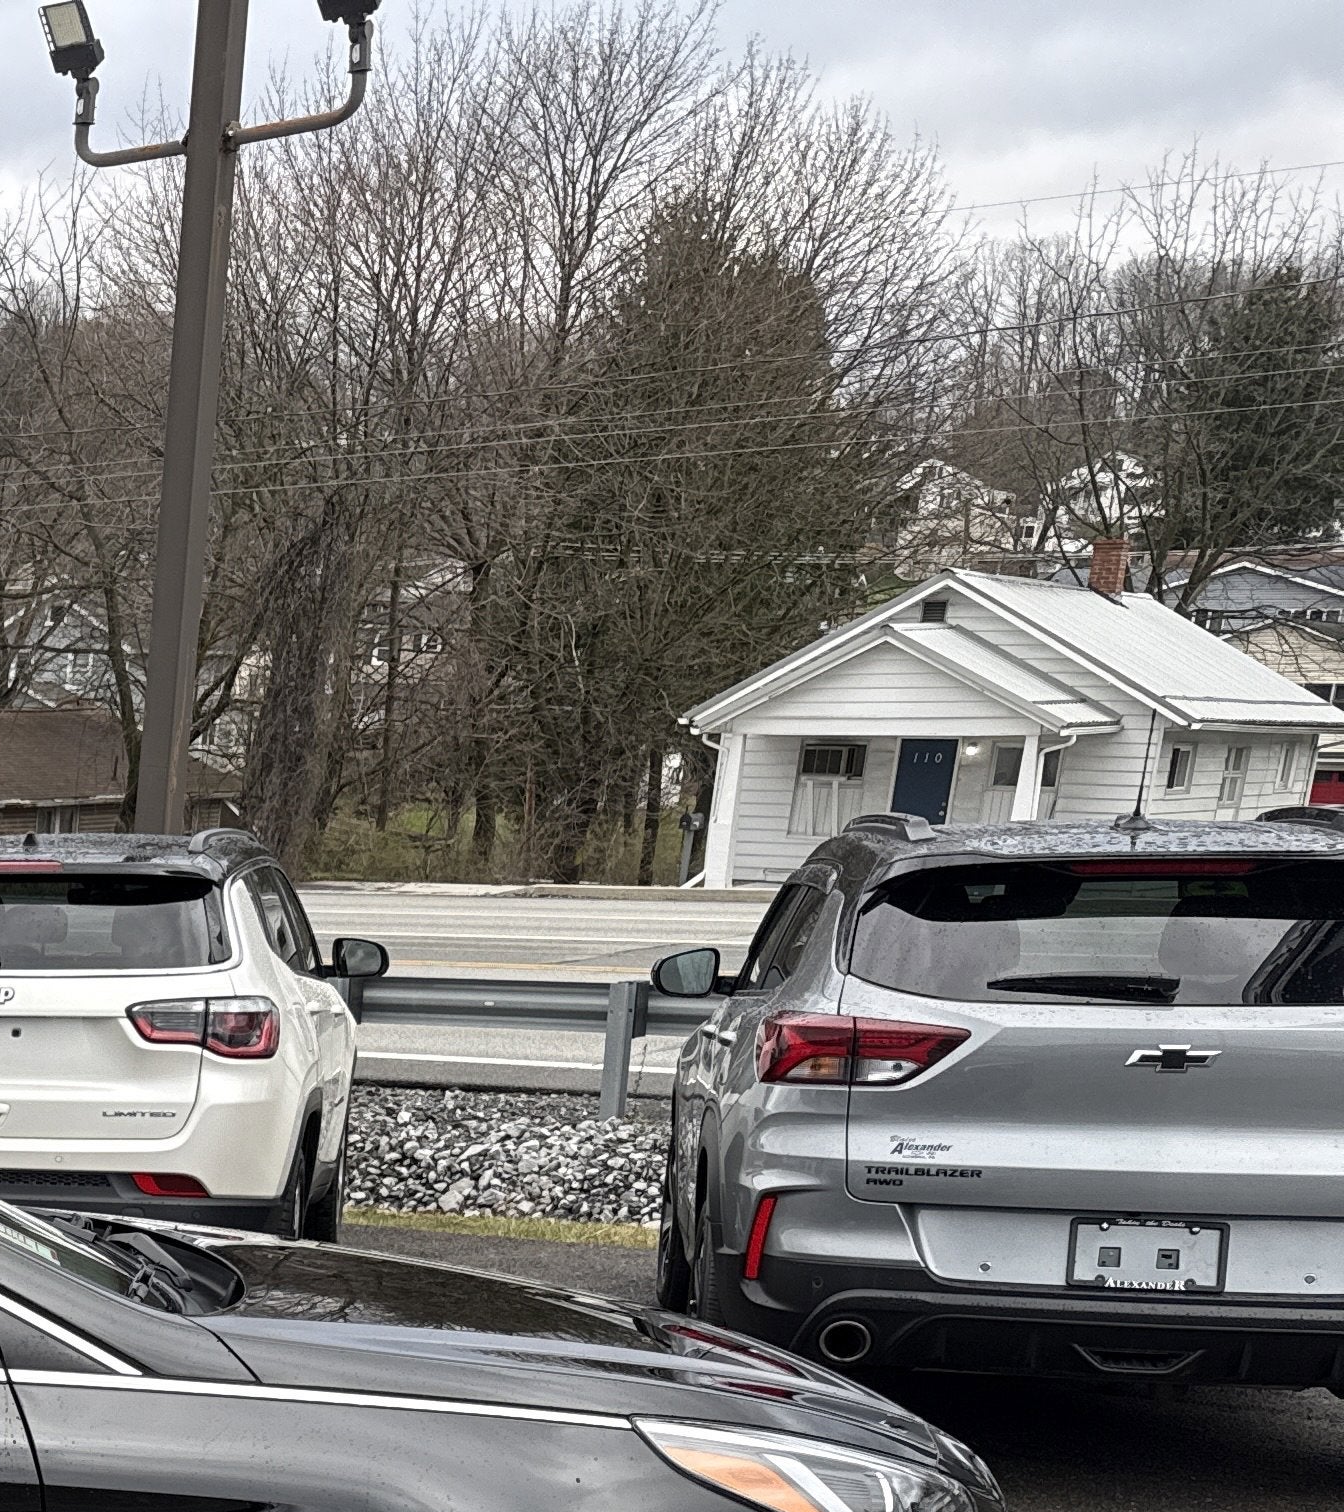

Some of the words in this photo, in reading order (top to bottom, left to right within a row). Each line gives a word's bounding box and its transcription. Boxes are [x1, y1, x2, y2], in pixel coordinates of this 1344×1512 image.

[913, 752, 943, 764] 110
[102, 1110, 177, 1118] LIMITED
[889, 1142, 954, 1155] Alexander
[864, 1165, 984, 1179] TRAILBLAZER
[866, 1178, 904, 1187] AWD
[1104, 1277, 1187, 1291] ALEXANDER
